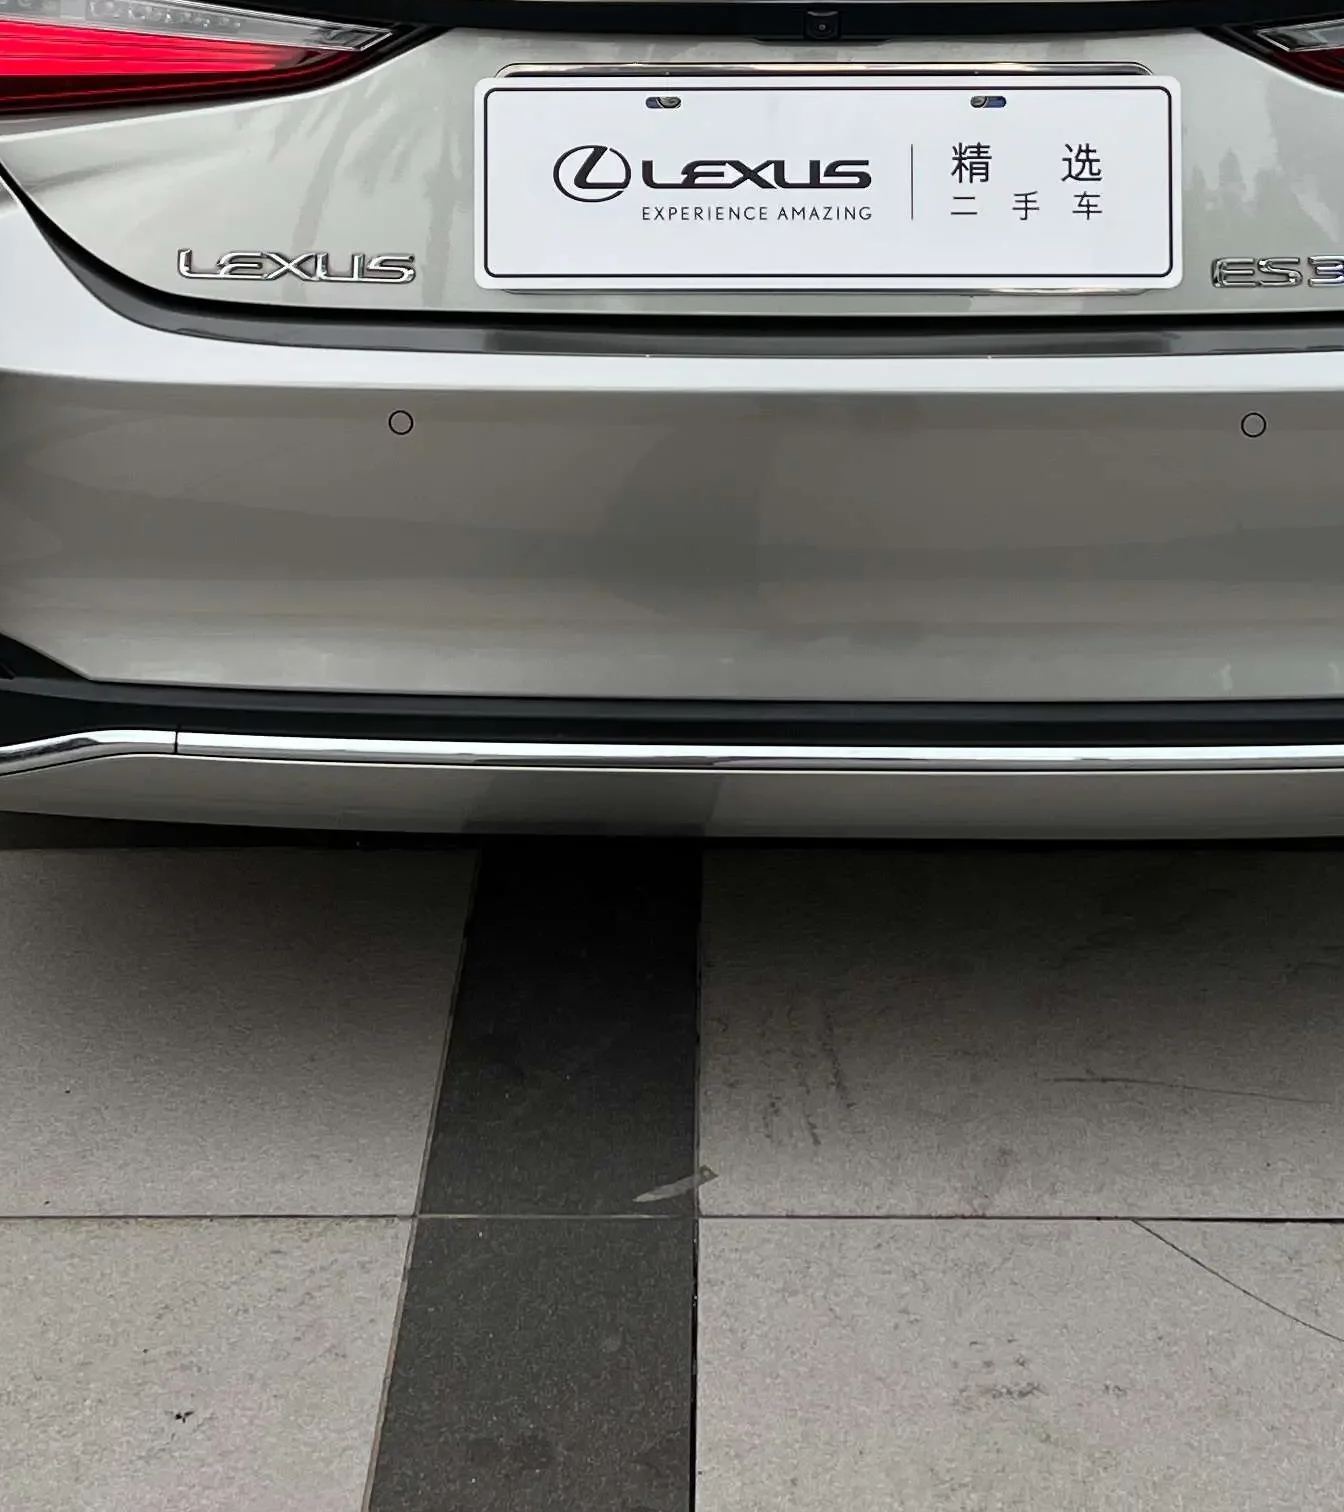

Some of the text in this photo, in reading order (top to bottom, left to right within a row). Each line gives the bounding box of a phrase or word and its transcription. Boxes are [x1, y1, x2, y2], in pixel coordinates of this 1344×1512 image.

[641, 159, 873, 189] LEXUS
[950, 141, 1104, 184] 精选
[641, 206, 873, 221] EXPERIENCE AMAZING
[950, 190, 1104, 221] 二手车
[177, 248, 416, 284] LEXUS
